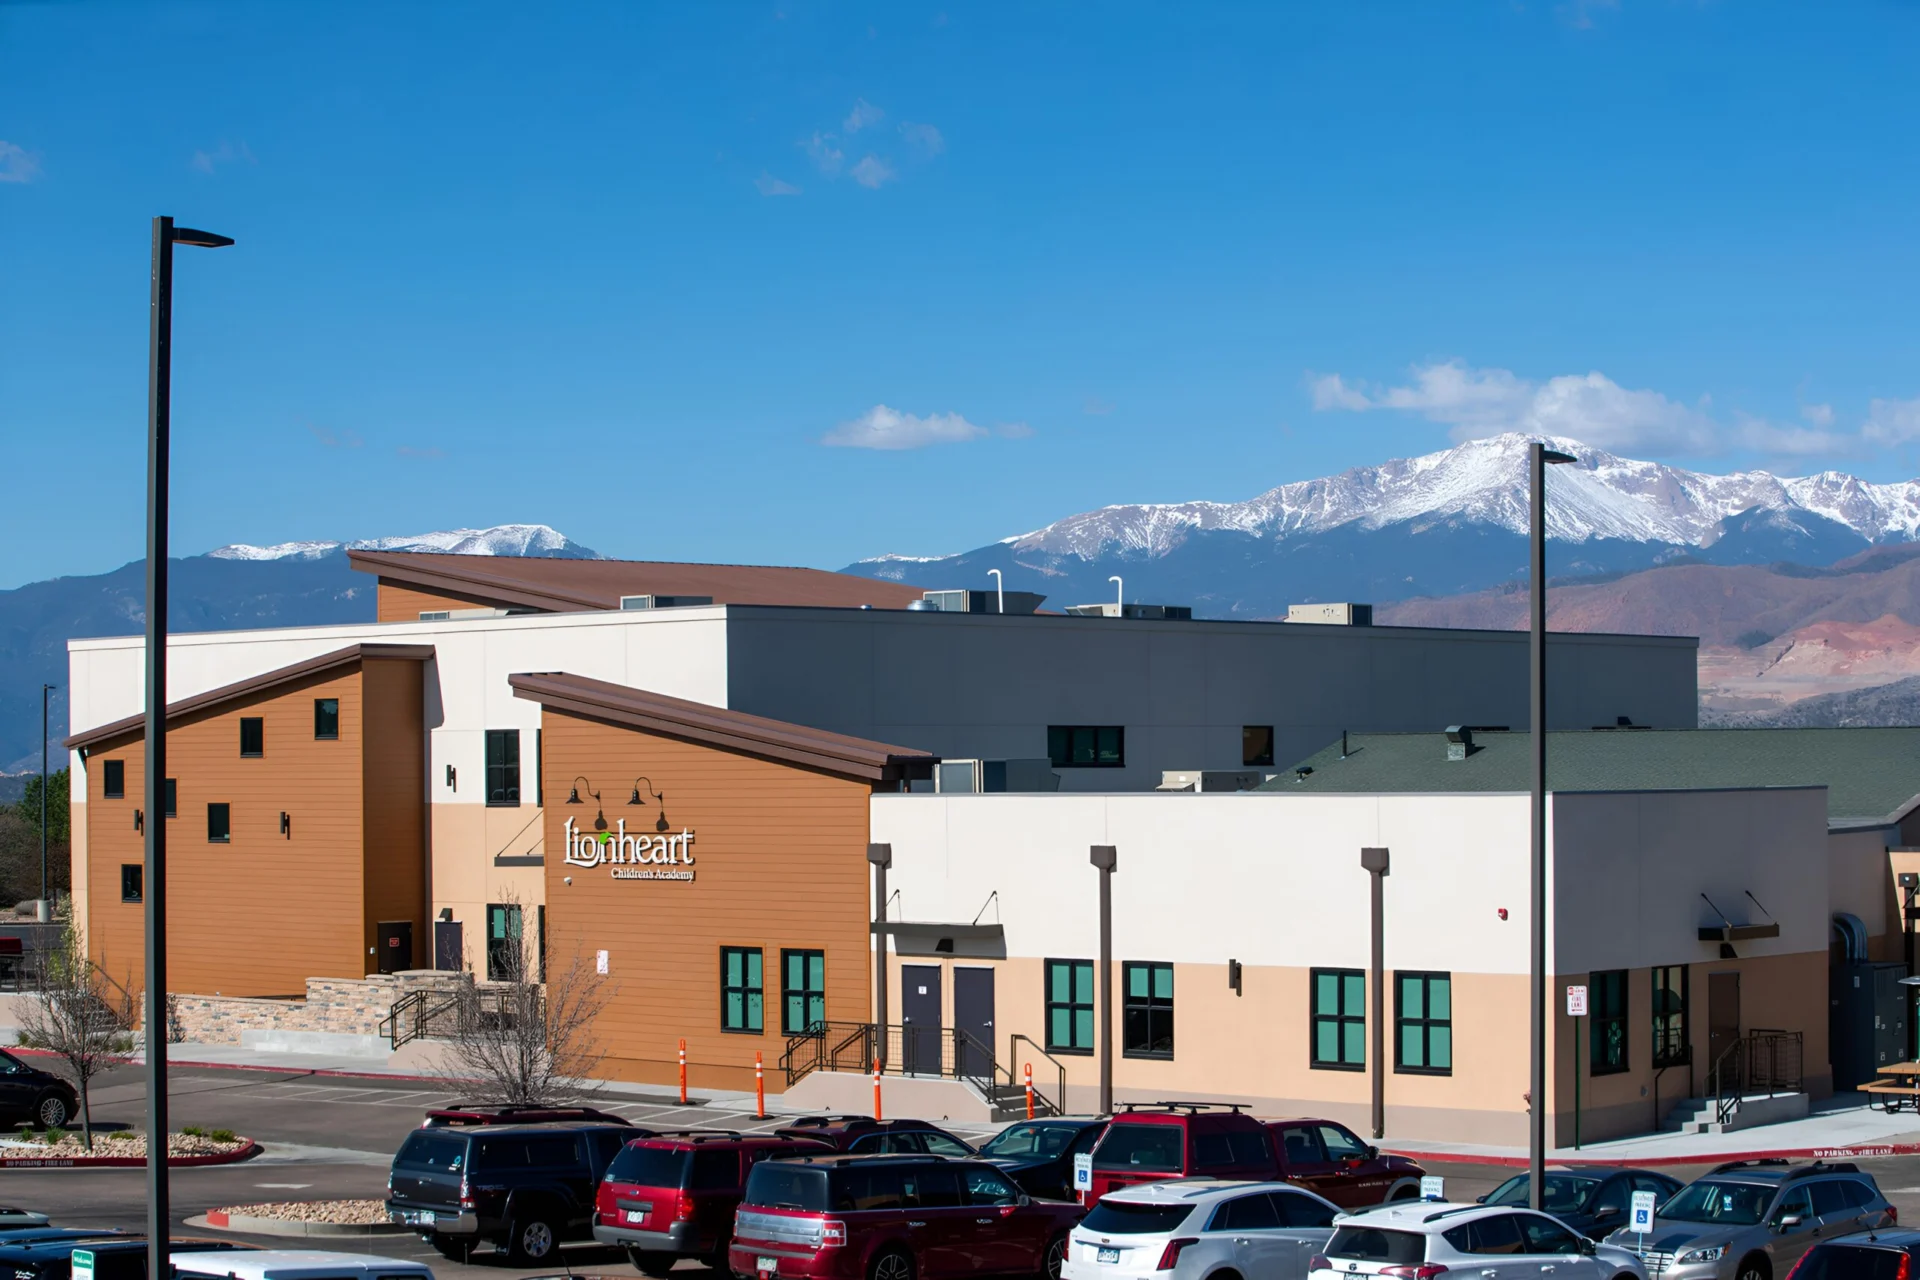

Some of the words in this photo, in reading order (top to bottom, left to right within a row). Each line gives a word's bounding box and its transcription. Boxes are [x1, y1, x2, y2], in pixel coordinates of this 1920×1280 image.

[563, 816, 694, 868] Lionheart
[611, 867, 653, 880] Children's
[656, 868, 694, 882] Academy
[1824, 1149, 1854, 1157] PARKING
